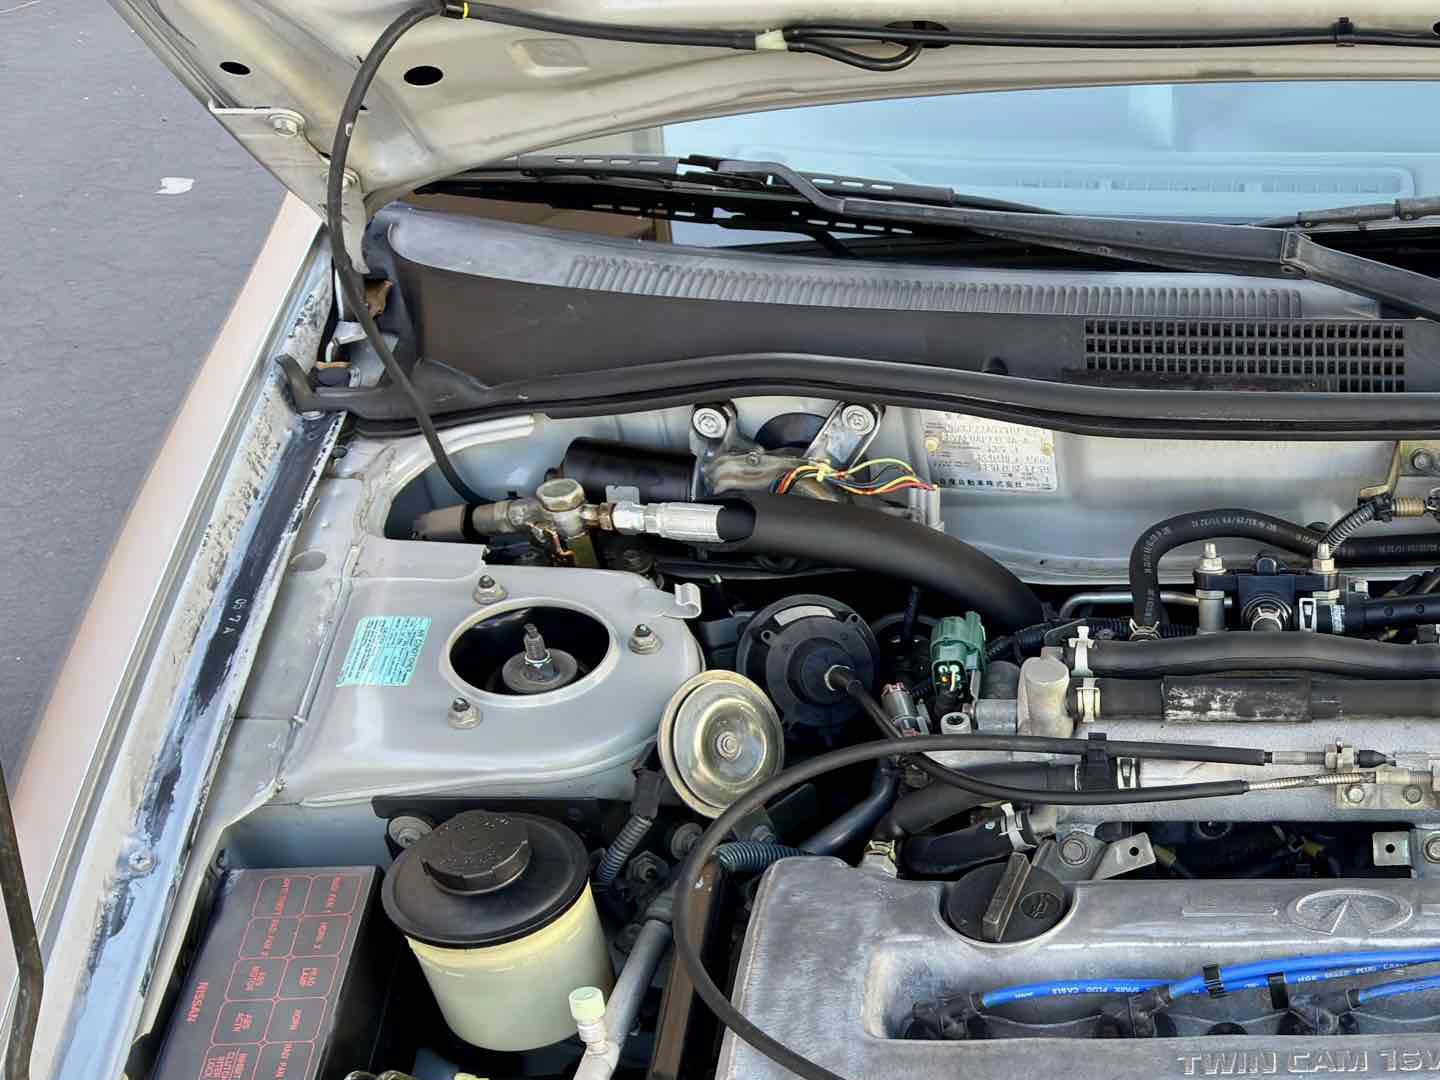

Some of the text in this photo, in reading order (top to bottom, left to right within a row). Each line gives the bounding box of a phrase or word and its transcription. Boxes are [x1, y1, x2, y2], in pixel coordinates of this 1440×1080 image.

[188, 982, 208, 1022] NISSAN
[1176, 1050, 1278, 1076] TWIN
[1287, 1049, 1369, 1074] CAM
